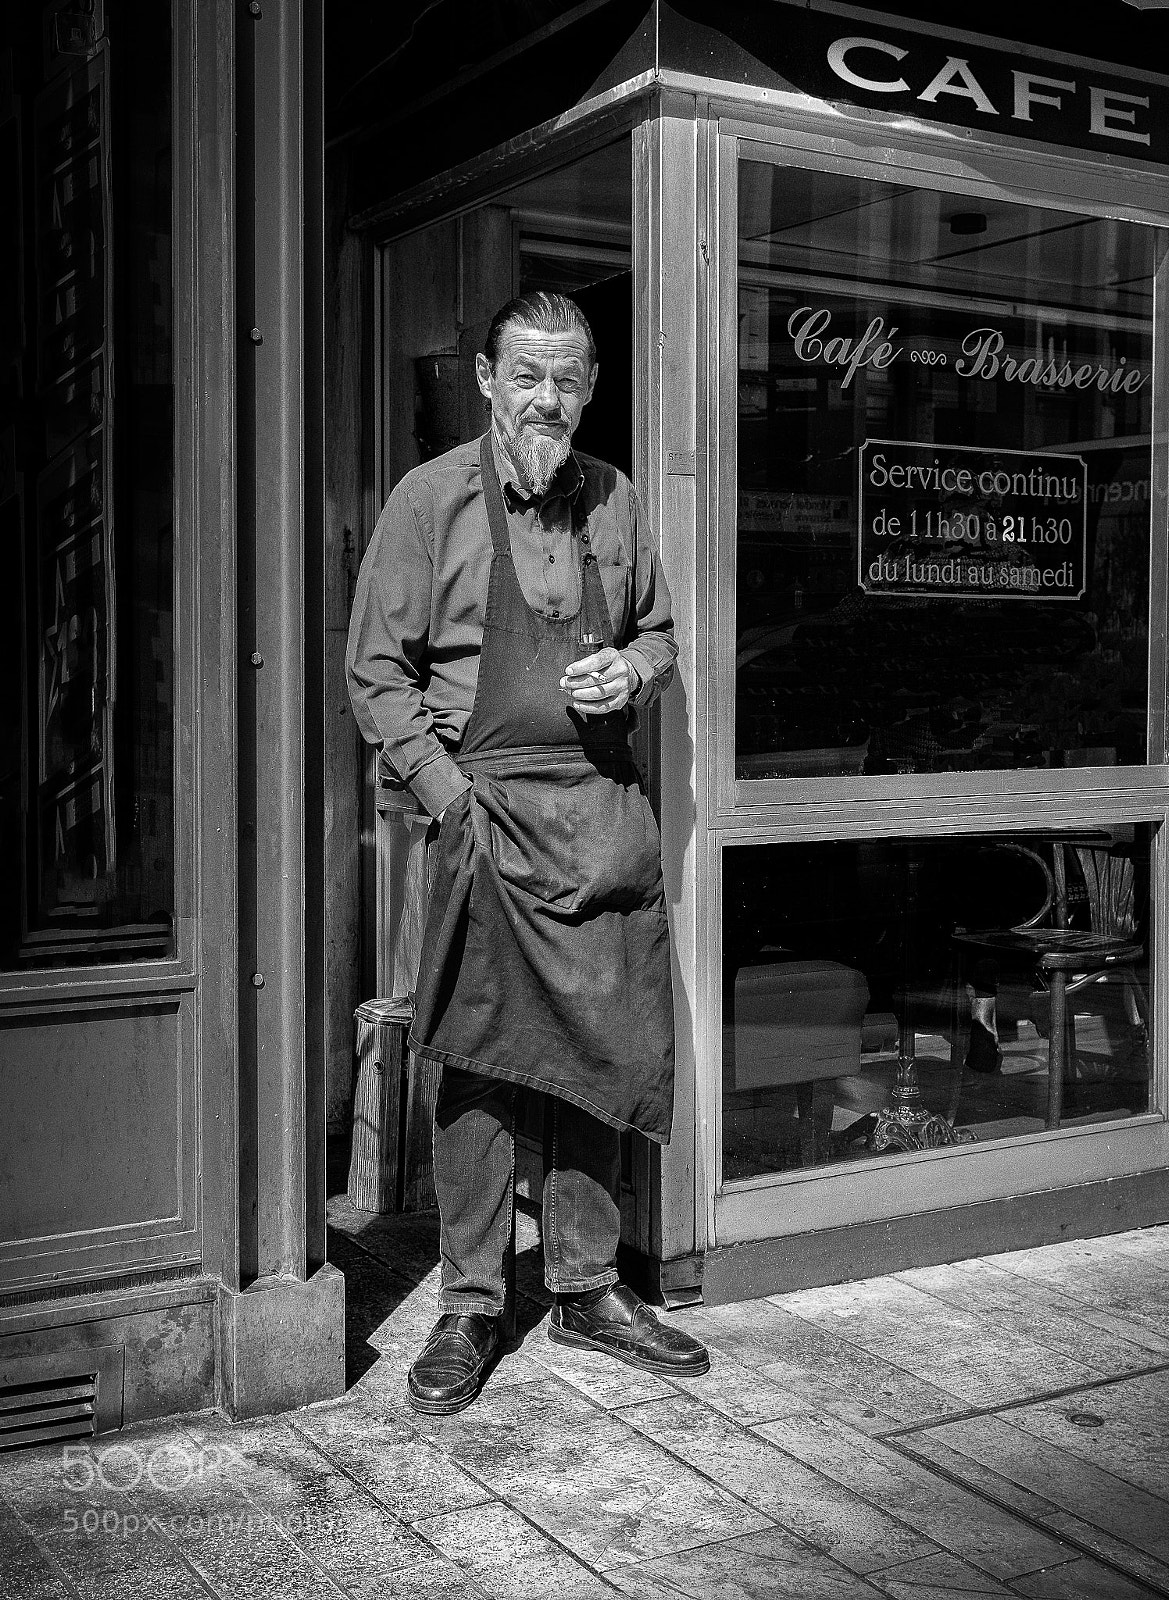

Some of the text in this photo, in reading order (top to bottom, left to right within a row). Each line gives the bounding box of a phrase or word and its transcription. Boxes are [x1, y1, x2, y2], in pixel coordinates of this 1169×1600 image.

[826, 36, 1151, 146] CAFE
[787, 306, 1150, 394] Café Brasserie
[869, 454, 1077, 499] Service continu
[871, 509, 901, 538] de
[909, 510, 981, 541] 11h30
[984, 512, 999, 542] à
[868, 554, 1075, 587] du lundi au samedi
